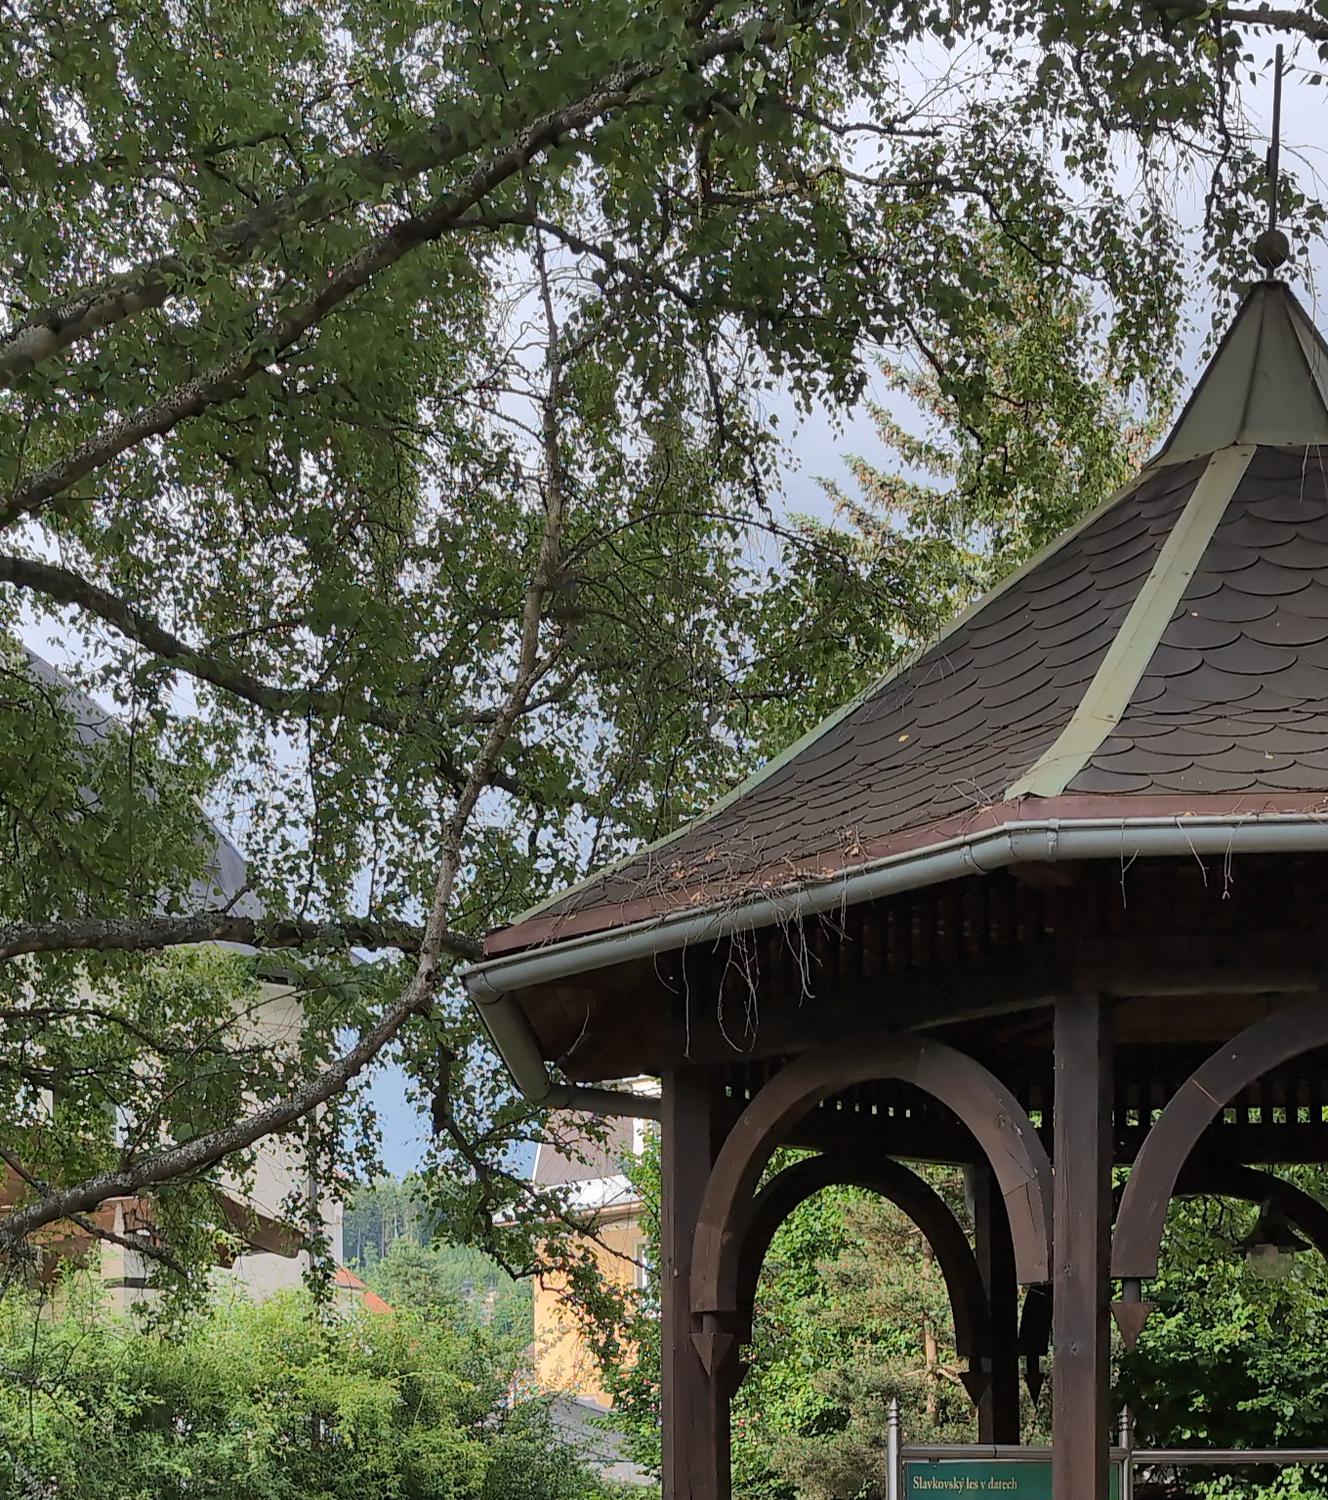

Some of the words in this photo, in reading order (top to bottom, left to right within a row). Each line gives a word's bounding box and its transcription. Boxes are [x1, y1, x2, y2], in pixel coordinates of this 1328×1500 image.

[913, 1475, 964, 1494] Slavkovský
[966, 1477, 978, 1490] les
[988, 1476, 1017, 1490] datech
